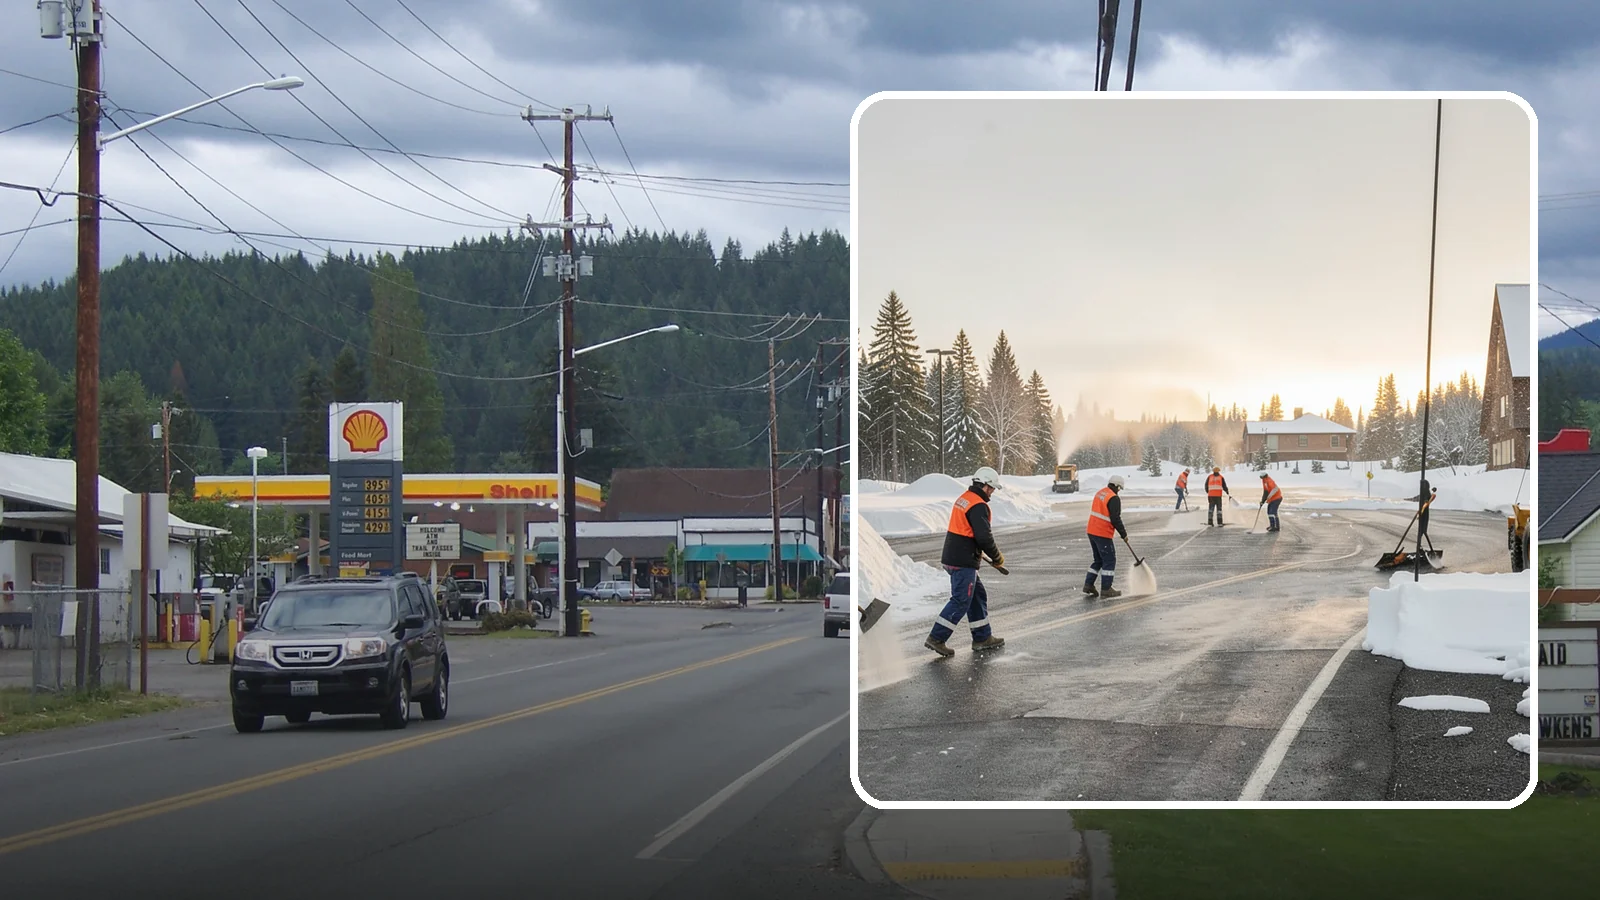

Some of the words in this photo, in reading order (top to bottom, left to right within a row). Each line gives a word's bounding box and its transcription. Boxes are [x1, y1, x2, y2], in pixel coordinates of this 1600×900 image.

[366, 480, 383, 490] 395
[490, 484, 547, 499] Shell
[365, 494, 383, 504] 405
[365, 508, 383, 518] 415
[365, 522, 383, 532] 429
